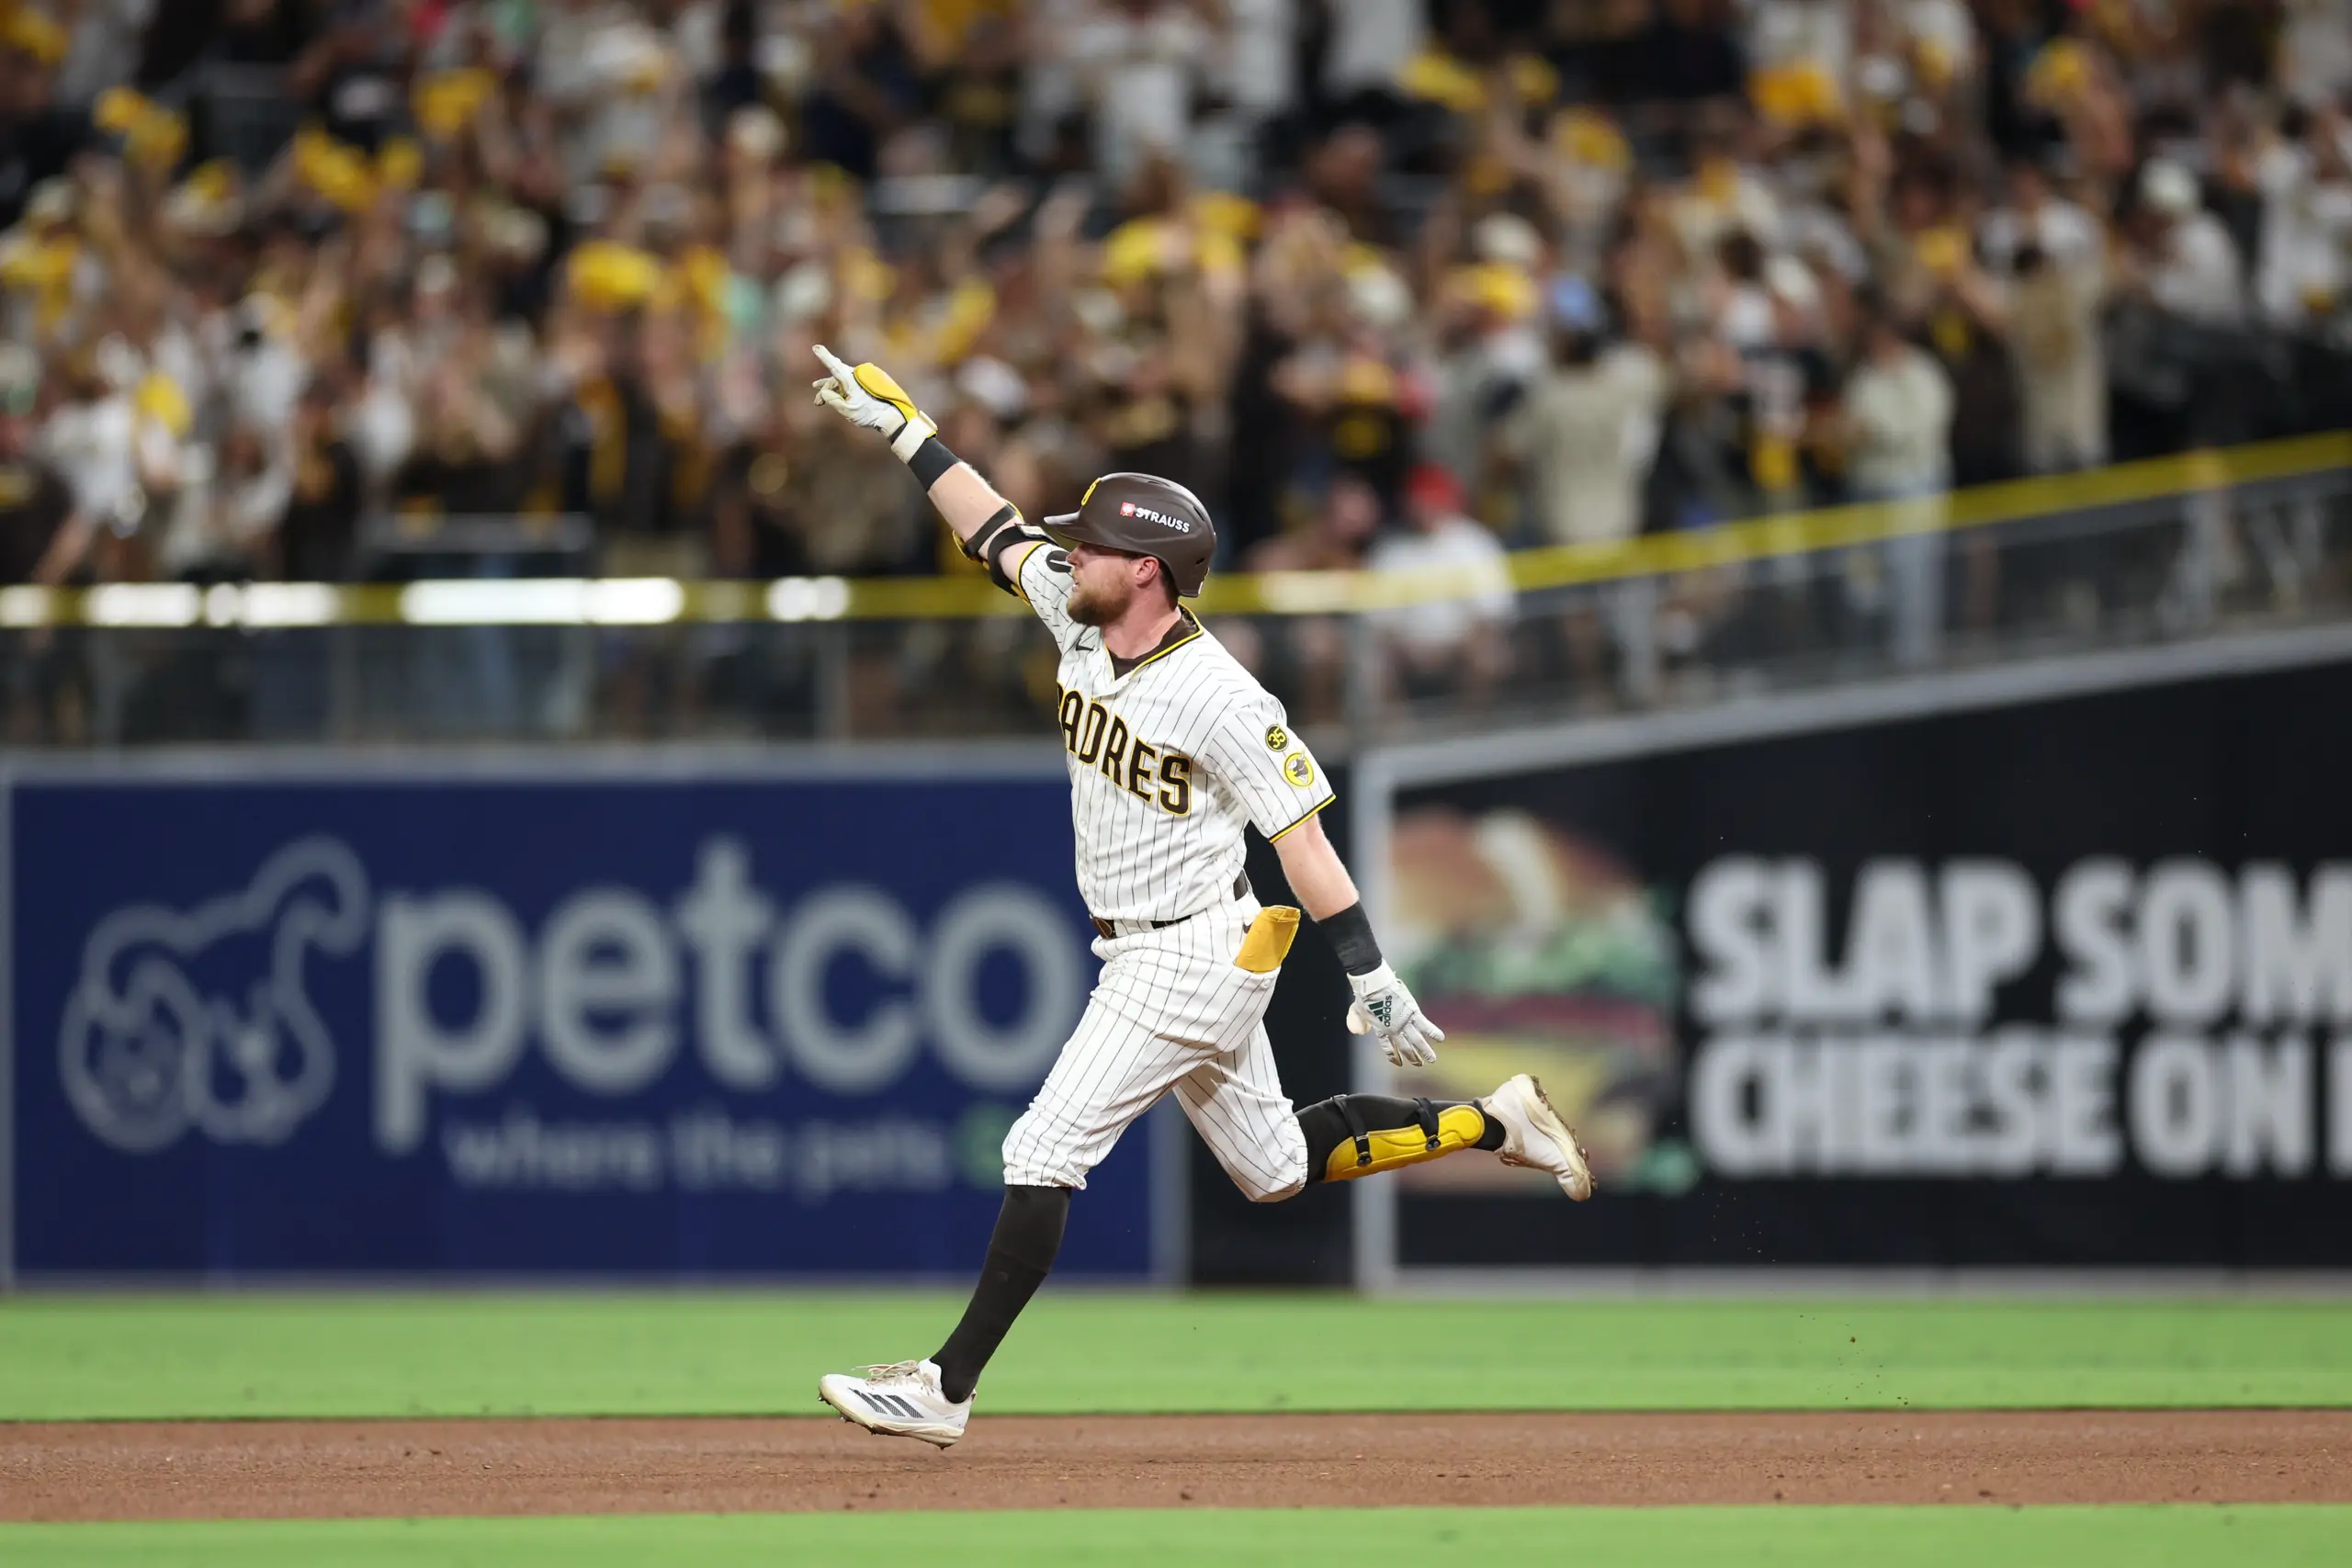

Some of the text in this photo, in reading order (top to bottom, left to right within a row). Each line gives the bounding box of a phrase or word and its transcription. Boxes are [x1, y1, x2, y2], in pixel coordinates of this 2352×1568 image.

[1135, 507, 1191, 534] STRAUSS
[1268, 726, 1287, 749] 35
[1689, 857, 2041, 1020] SLAP
[375, 840, 1082, 1153] petco
[1383, 995, 1393, 1027] adidas
[1690, 1028, 2120, 1174] CHEESE
[2129, 1030, 2313, 1175] ON
